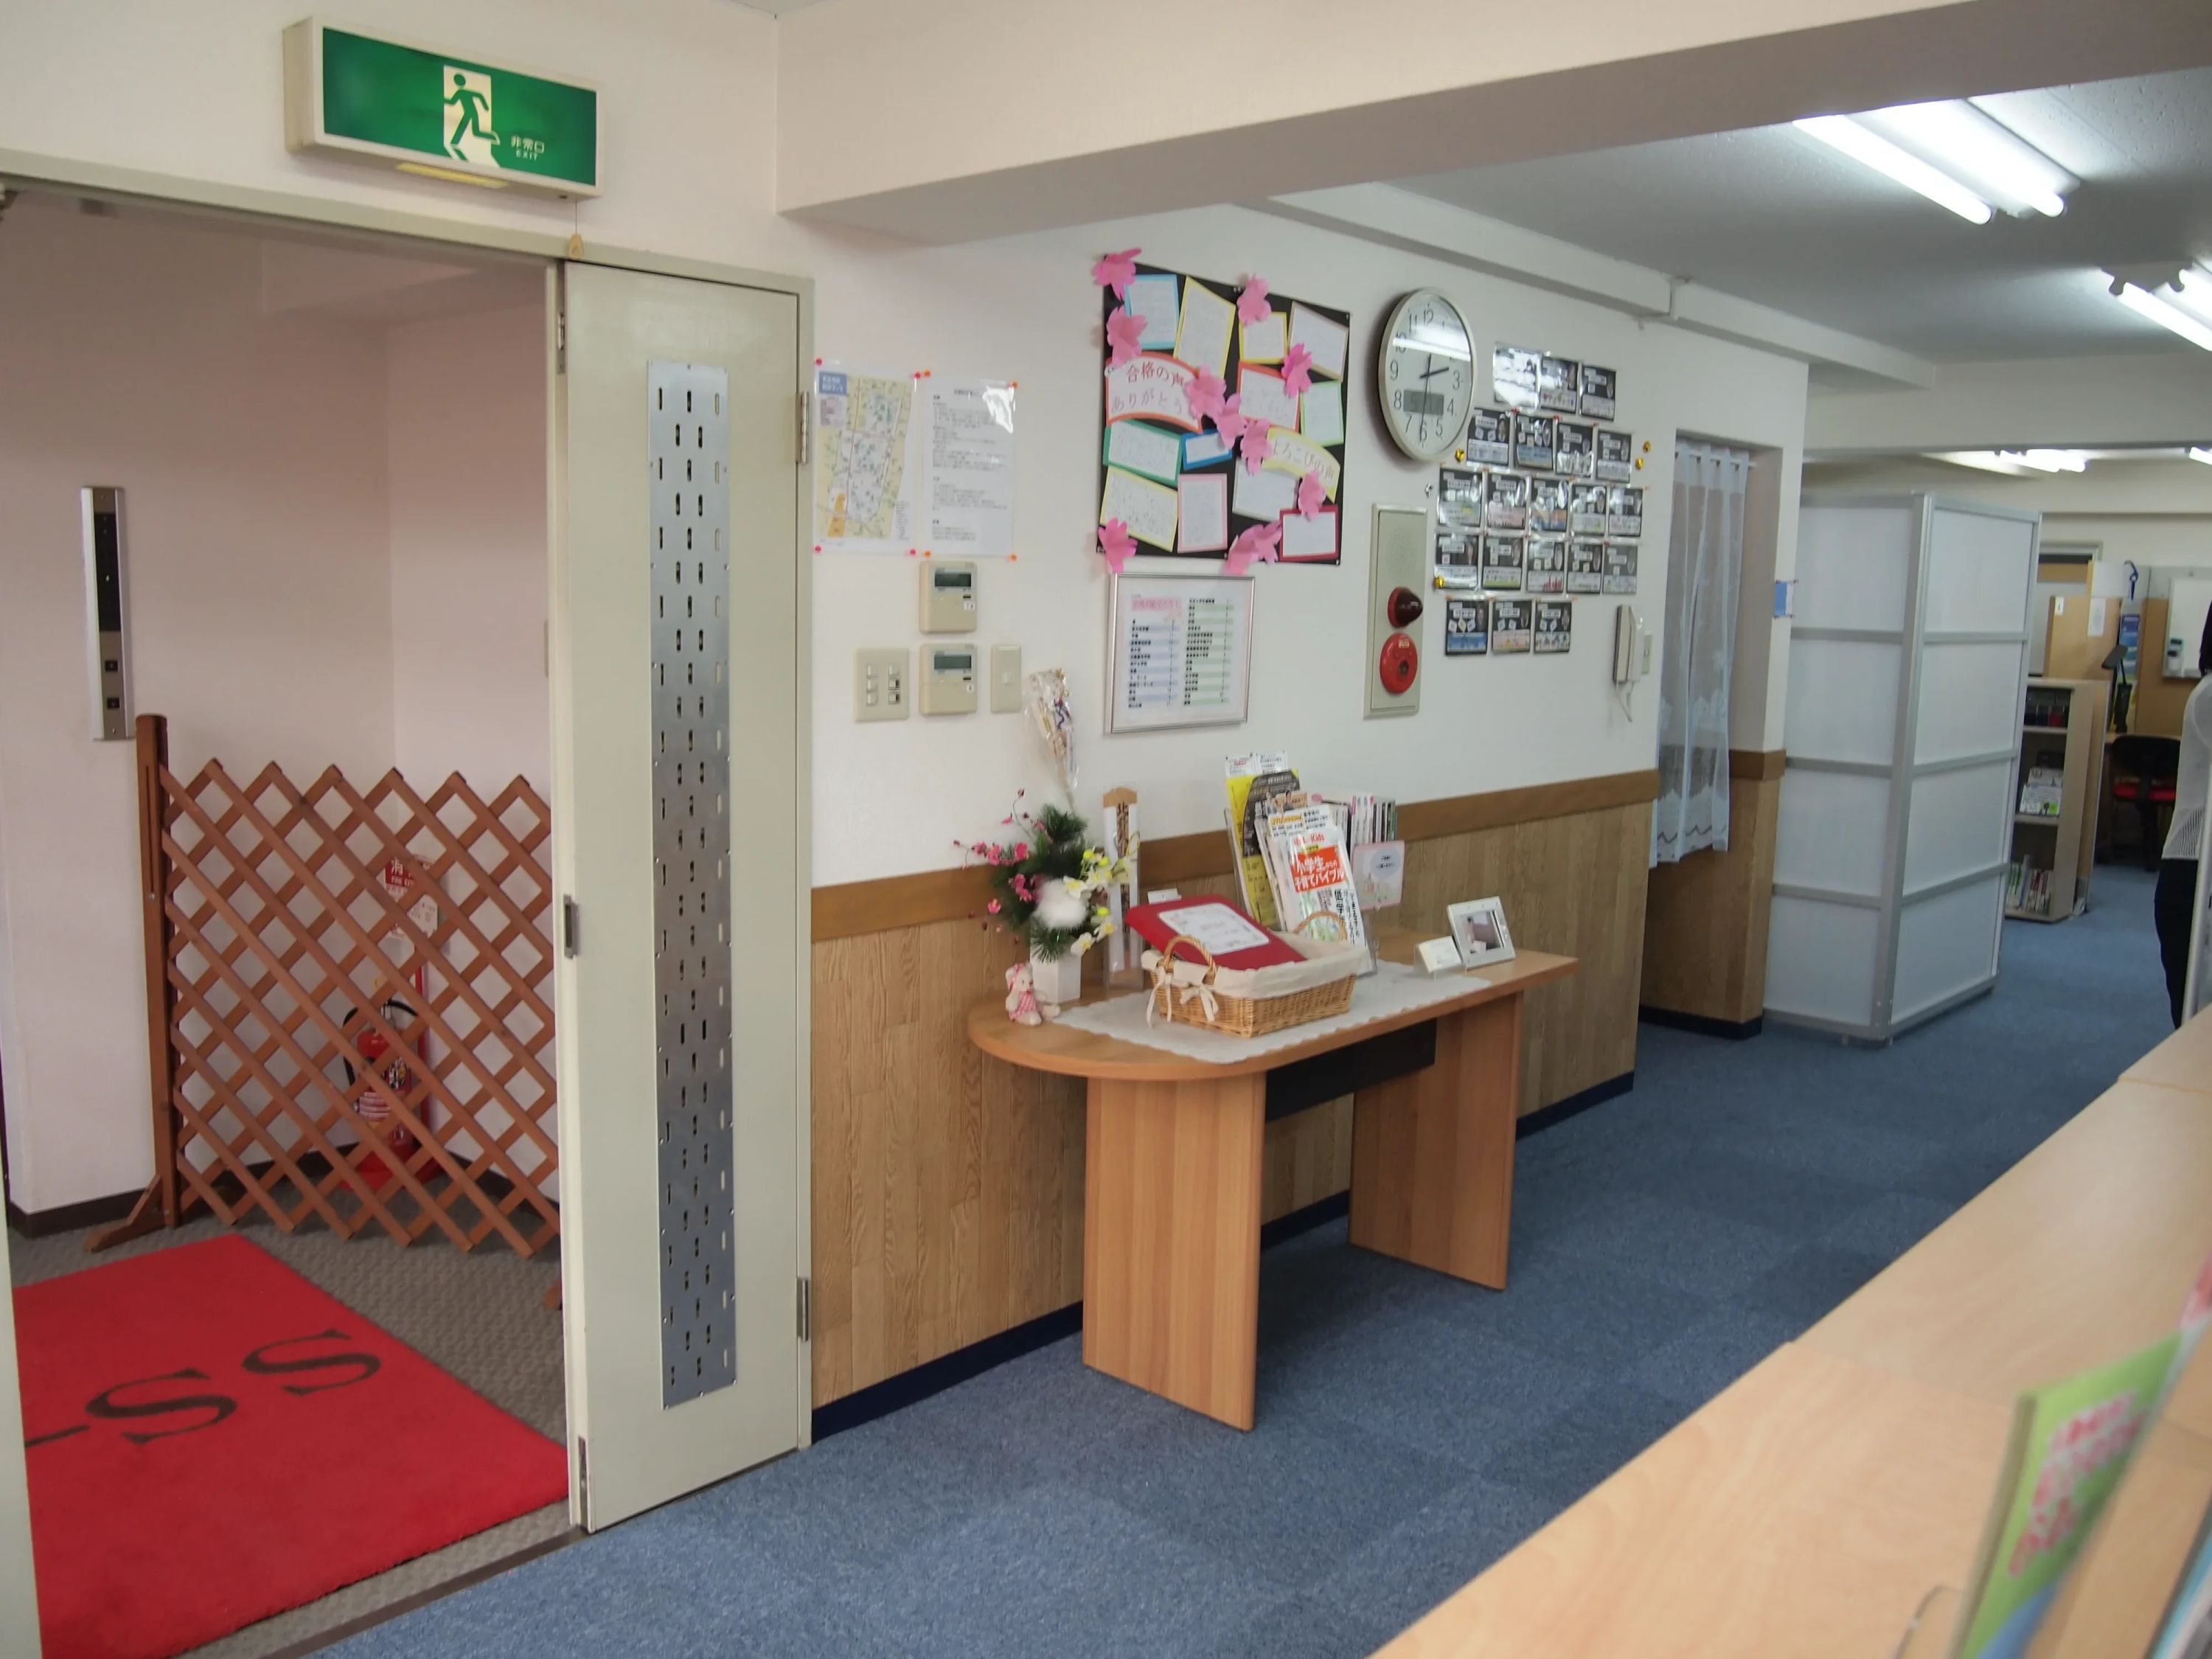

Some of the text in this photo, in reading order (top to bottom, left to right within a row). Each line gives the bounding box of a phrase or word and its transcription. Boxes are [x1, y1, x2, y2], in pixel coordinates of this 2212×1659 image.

[511, 135, 545, 153] 非常口
[516, 149, 538, 161] EXIT
[1409, 313, 1418, 334] 11
[1424, 309, 1434, 327] 12
[1127, 361, 1185, 388] 合格の声
[1390, 359, 1399, 380] 9
[1452, 369, 1461, 391] 3
[1111, 388, 1183, 414] ありがとう
[1394, 389, 1402, 411] 8
[1447, 398, 1455, 417] 4
[1405, 414, 1413, 434] 7
[1419, 420, 1427, 442] 6
[1435, 416, 1444, 437] 5
